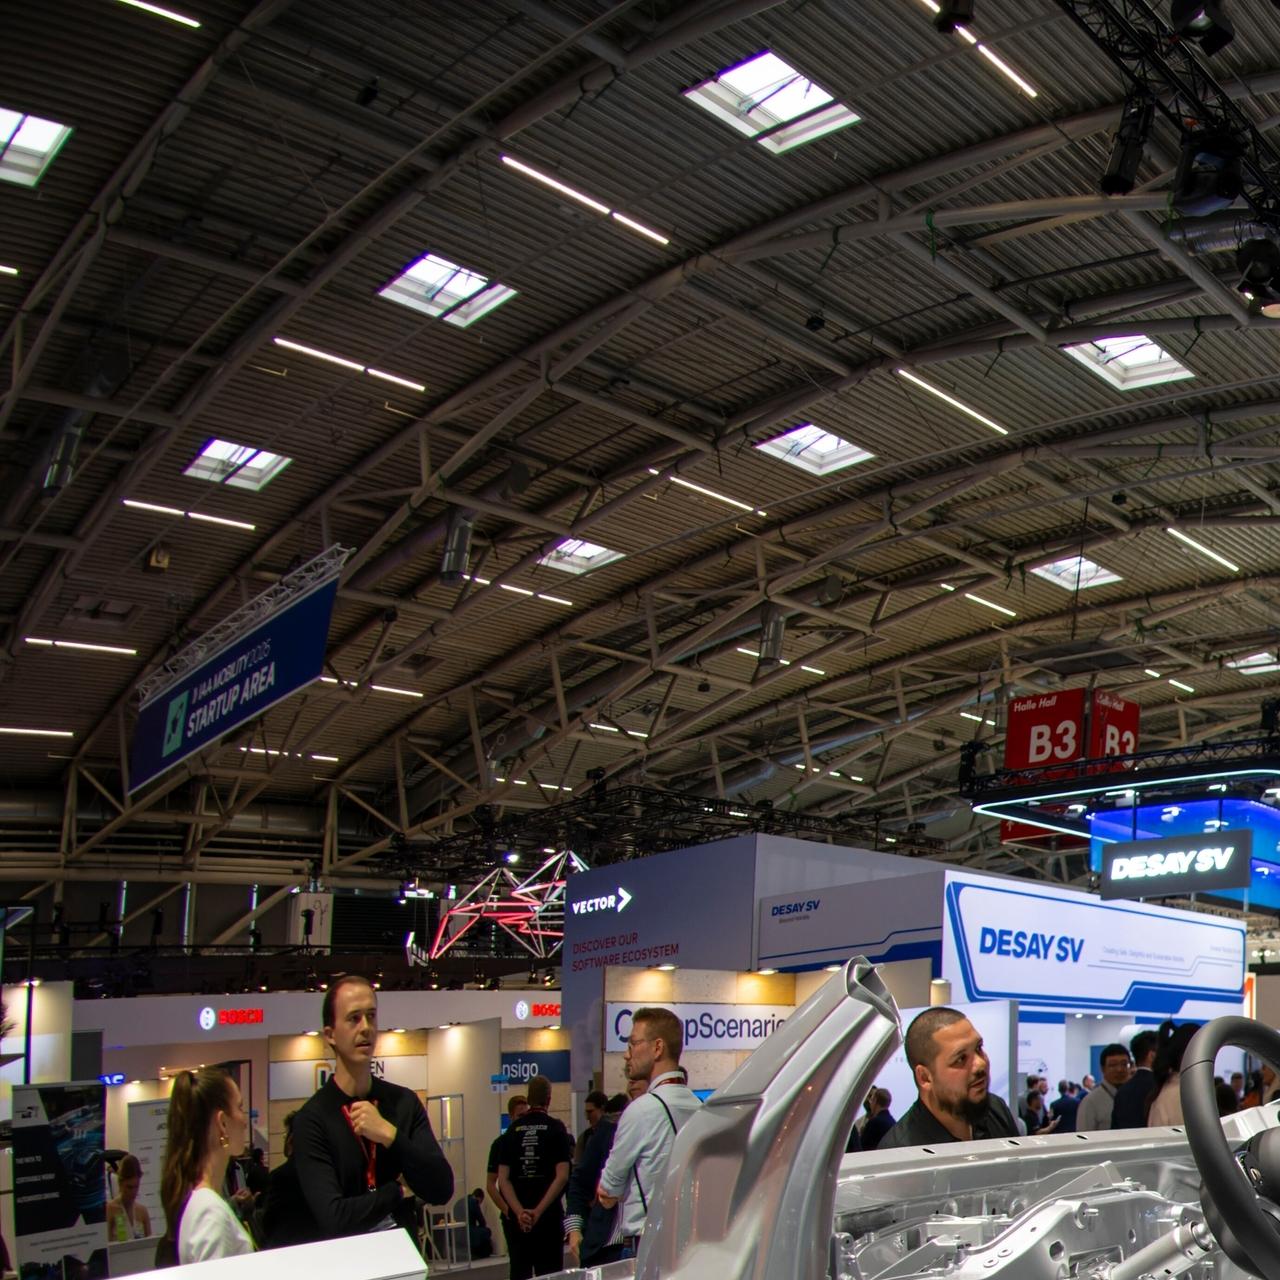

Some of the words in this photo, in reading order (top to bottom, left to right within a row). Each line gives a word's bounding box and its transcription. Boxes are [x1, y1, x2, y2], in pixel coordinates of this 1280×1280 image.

[186, 687, 240, 738] STARTUP
[240, 661, 276, 704] AREA
[1013, 700, 1037, 712] Halle
[1038, 695, 1057, 708] Hall
[1028, 719, 1077, 764] B3
[1104, 723, 1135, 768] B3
[1111, 850, 1197, 881] DESAY
[1195, 847, 1234, 872] SV
[572, 895, 616, 915] VECTOR
[771, 903, 806, 917] DESAY
[806, 899, 821, 912] SV
[572, 936, 617, 956] DISCOVER
[618, 932, 639, 947] OUR
[979, 926, 1055, 961] DESAY
[1055, 935, 1085, 963] SV
[572, 953, 621, 972] SOFTWARE
[622, 943, 680, 964] ECOSYSTEM
[218, 1008, 263, 1025] BOSCH
[532, 1003, 561, 1017] BOSC
